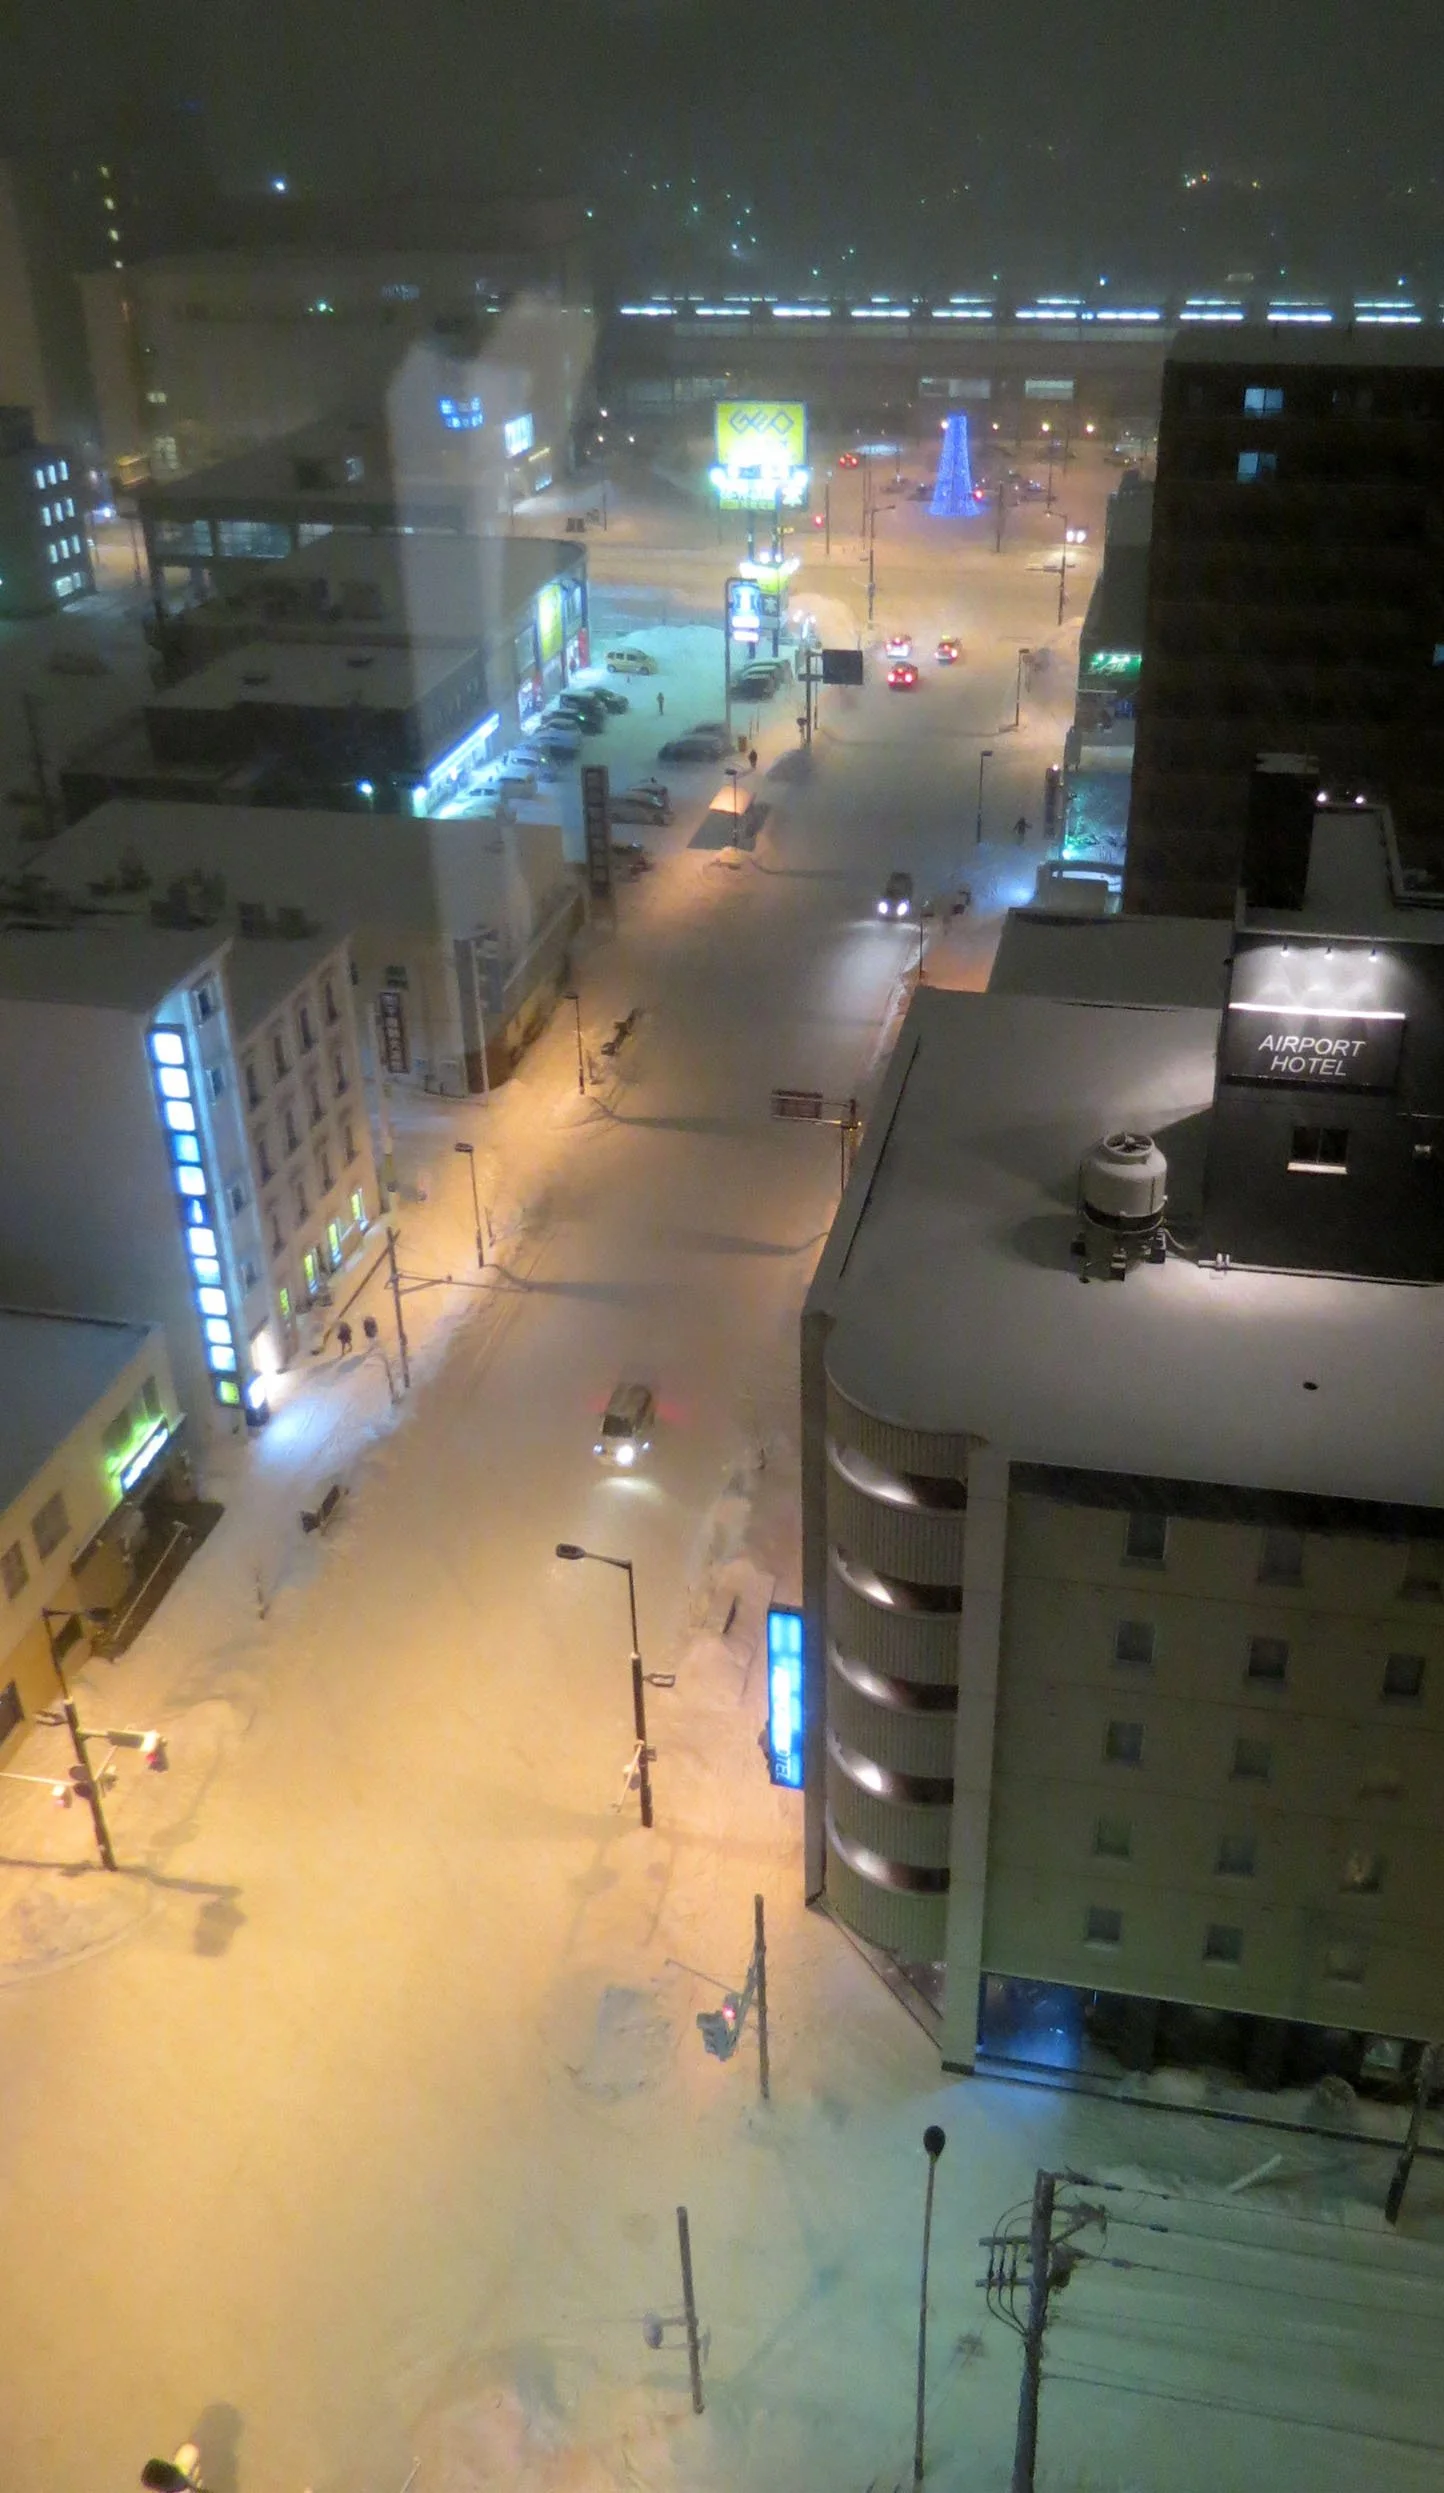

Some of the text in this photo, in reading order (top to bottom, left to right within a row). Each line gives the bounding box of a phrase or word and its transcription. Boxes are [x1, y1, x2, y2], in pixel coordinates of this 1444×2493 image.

[730, 410, 794, 434] GEO
[1258, 1034, 1367, 1057] AIRPORT
[1270, 1055, 1346, 1076] HOTEL
